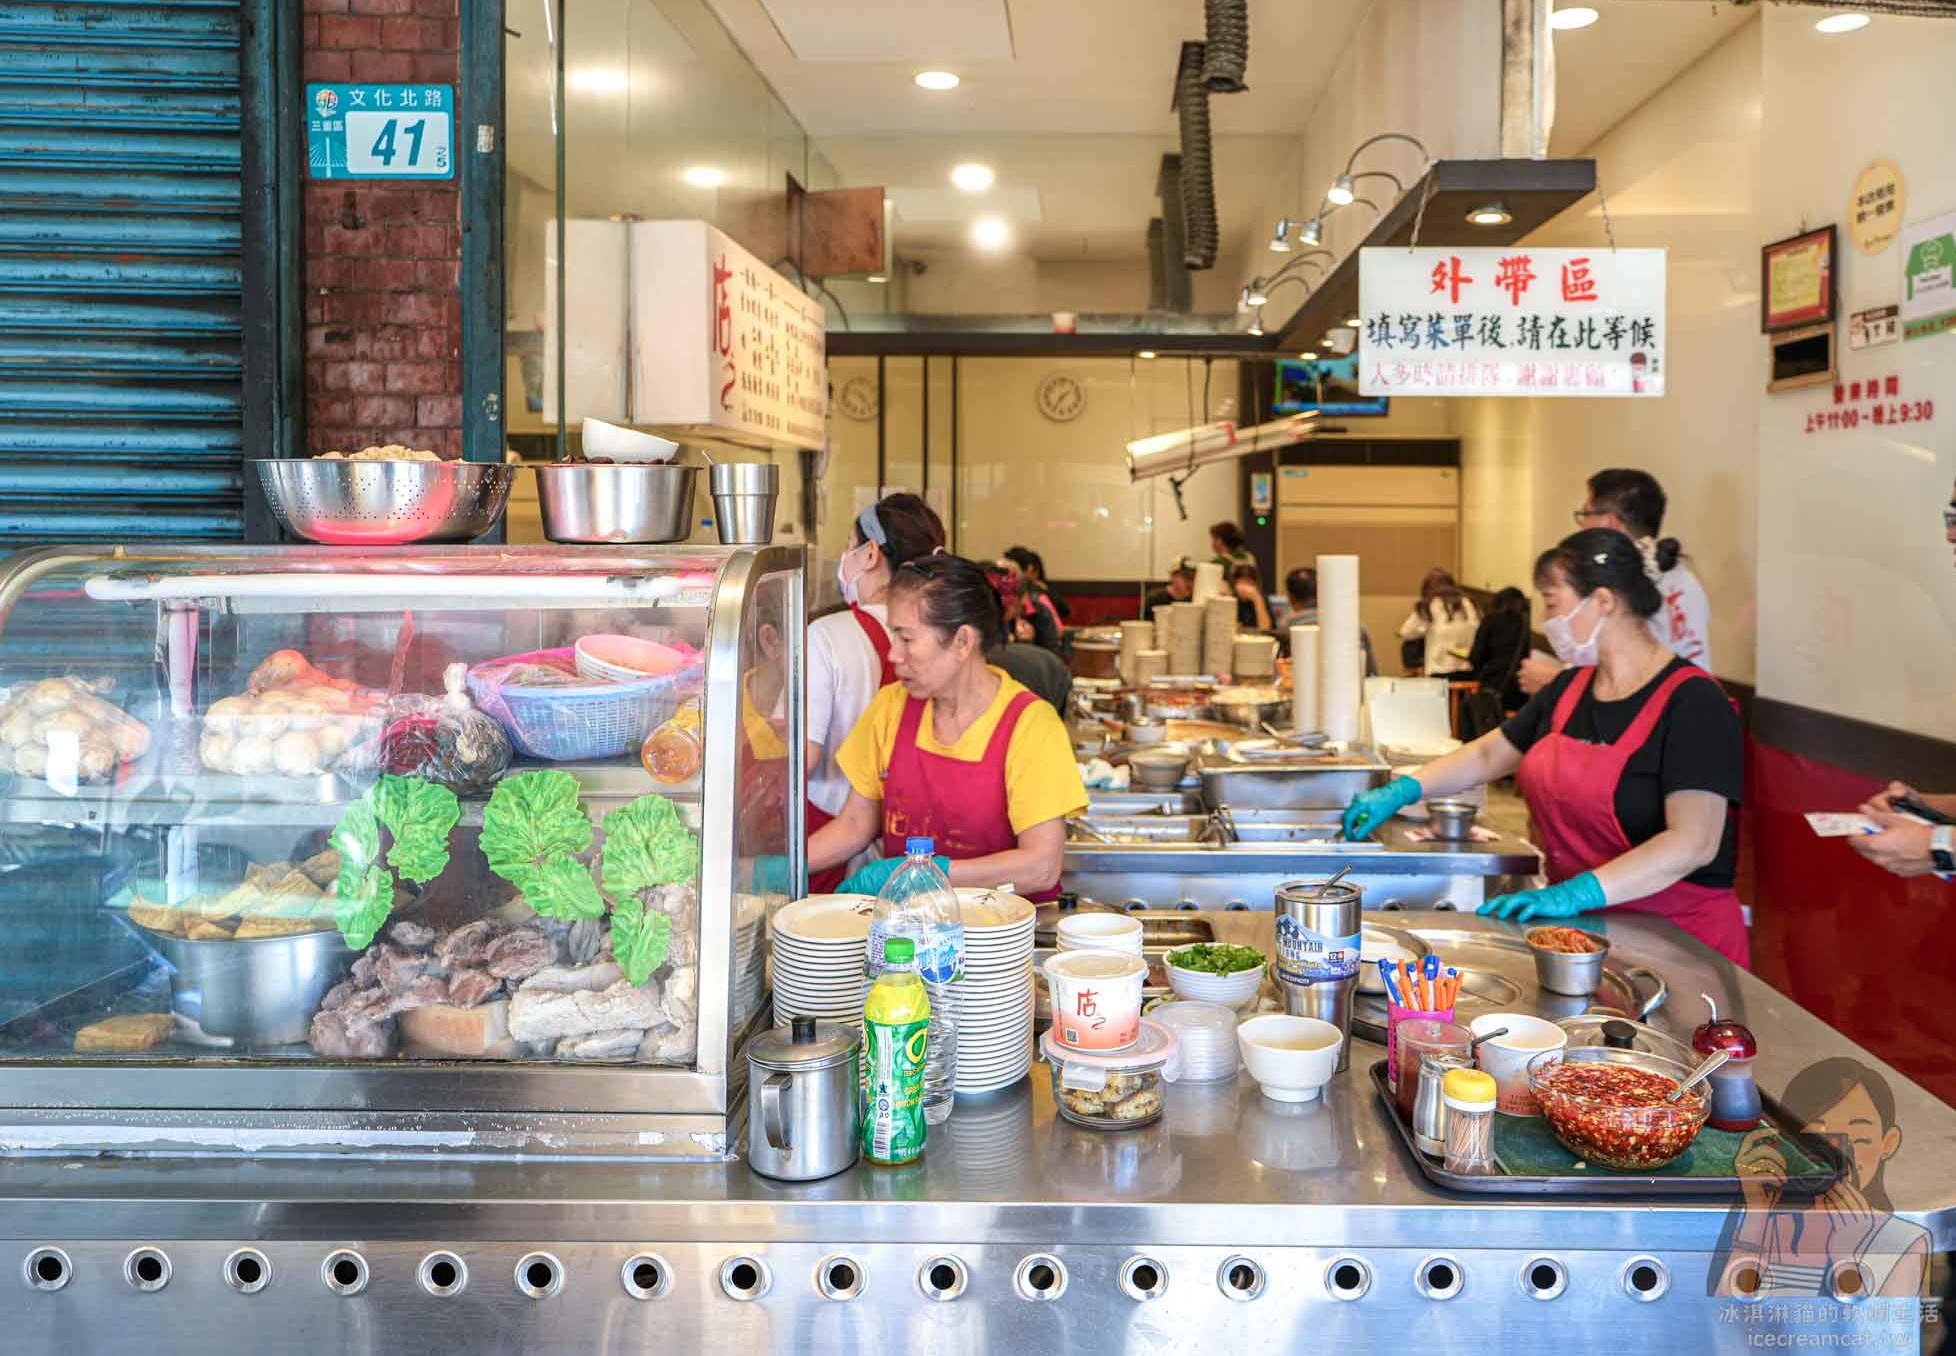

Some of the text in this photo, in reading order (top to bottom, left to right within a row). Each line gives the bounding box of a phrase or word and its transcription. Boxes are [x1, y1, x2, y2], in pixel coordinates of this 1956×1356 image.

[349, 88, 442, 107] 文化北路
[371, 119, 426, 166] 41
[1430, 255, 1598, 306] 外帶區
